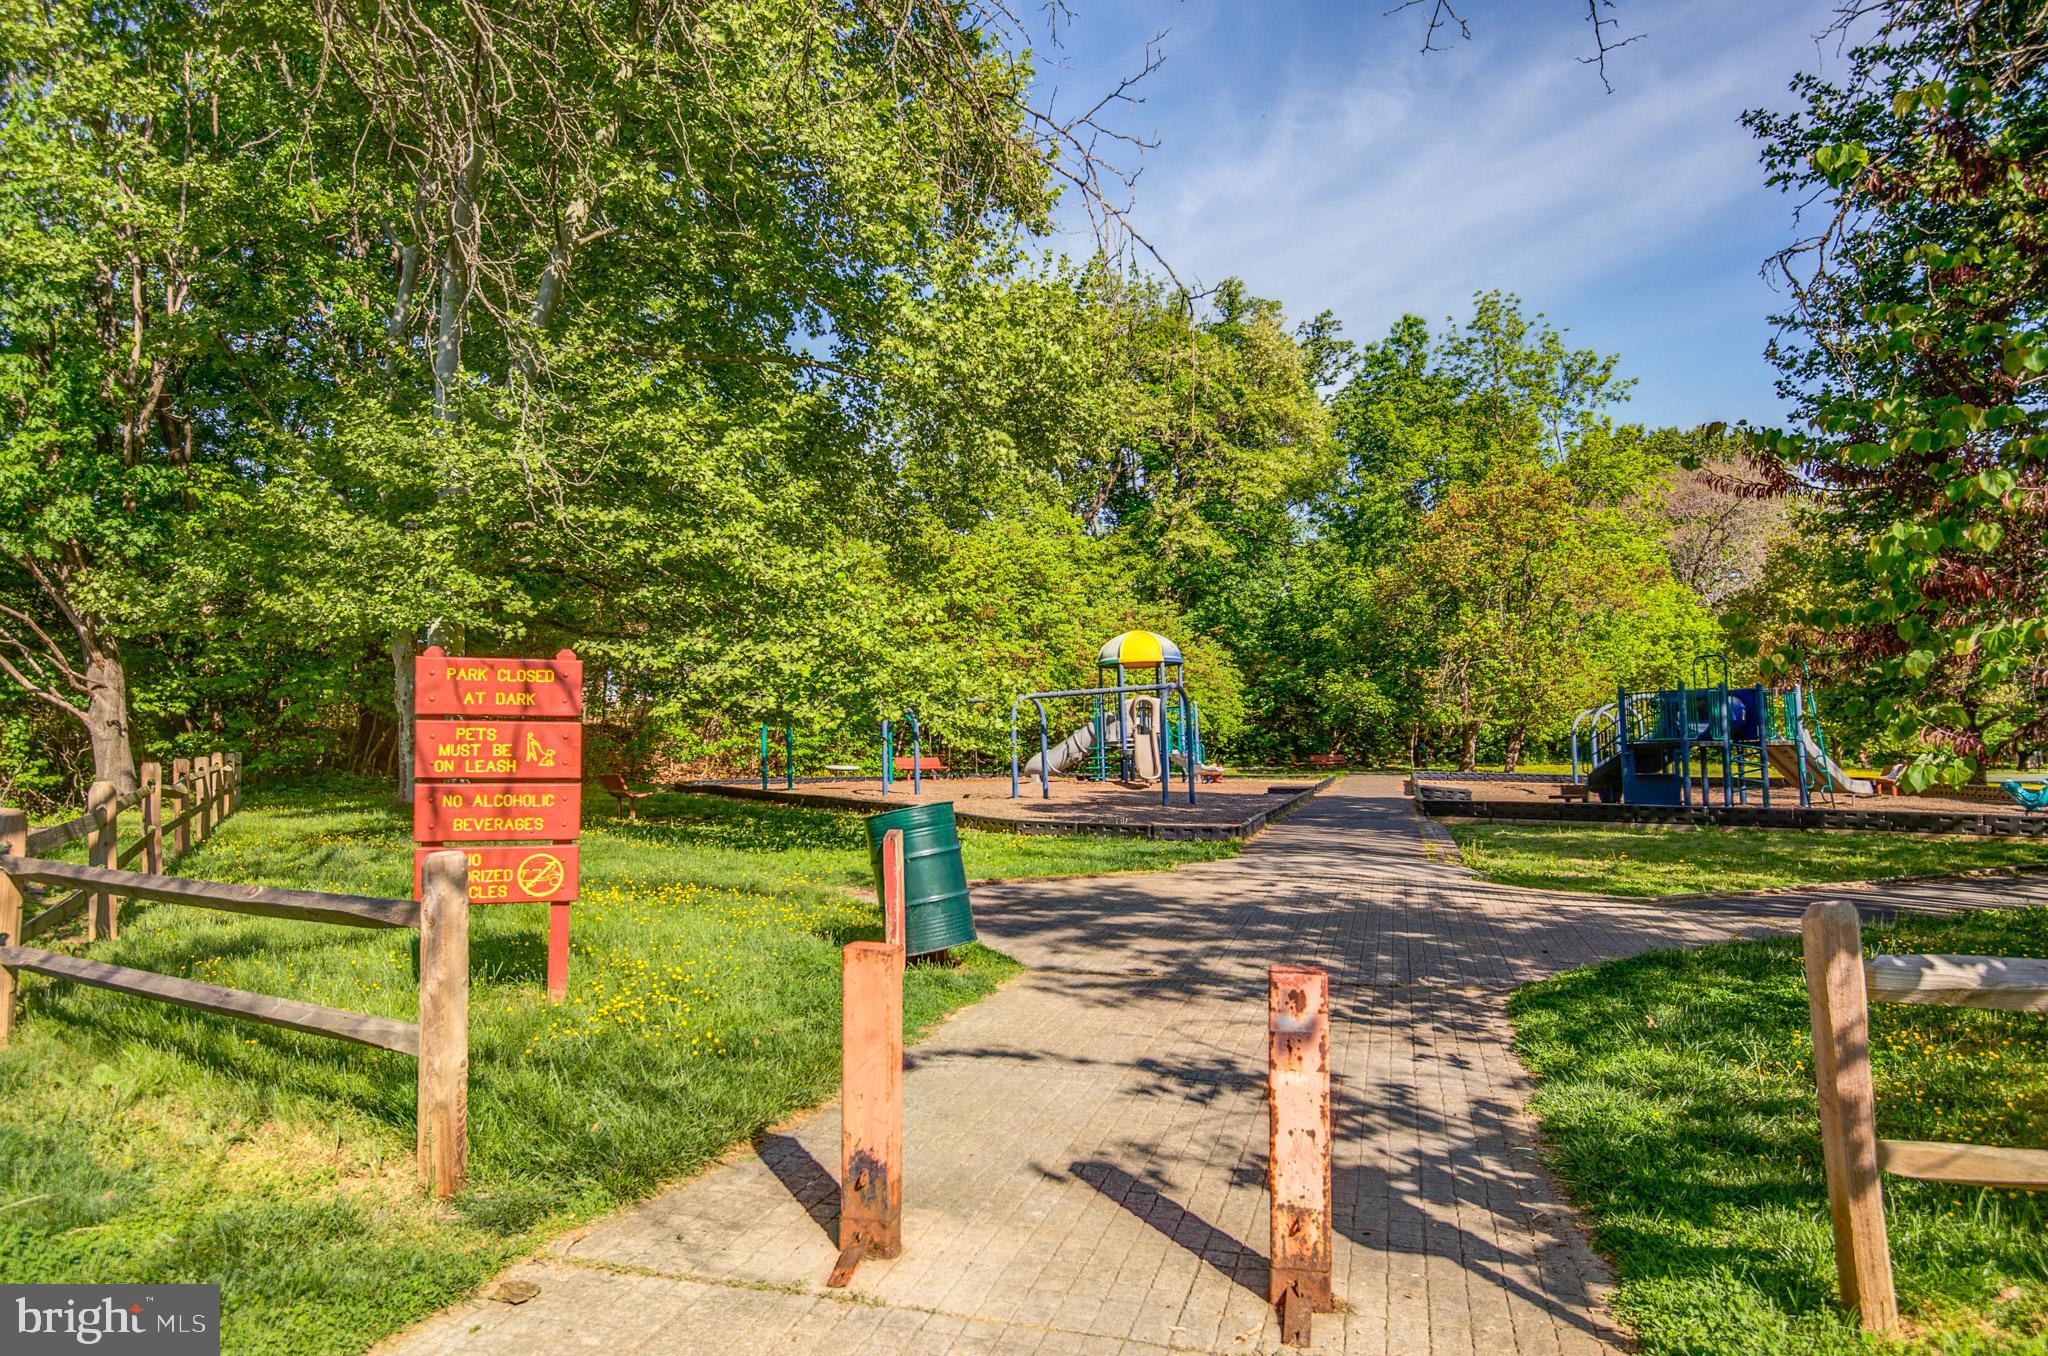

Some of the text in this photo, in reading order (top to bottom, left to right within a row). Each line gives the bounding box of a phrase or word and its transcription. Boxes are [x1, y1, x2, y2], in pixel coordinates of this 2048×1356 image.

[446, 667, 555, 683] PARK CLOSED
[463, 692, 536, 706] AT DARK
[455, 727, 497, 741] PETS
[438, 743, 512, 757] MUST BE
[434, 759, 517, 773] ON LEASH
[442, 794, 555, 808] NO ALCOHOLIC
[453, 817, 544, 832] BEVERAGES
[467, 853, 482, 867] O
